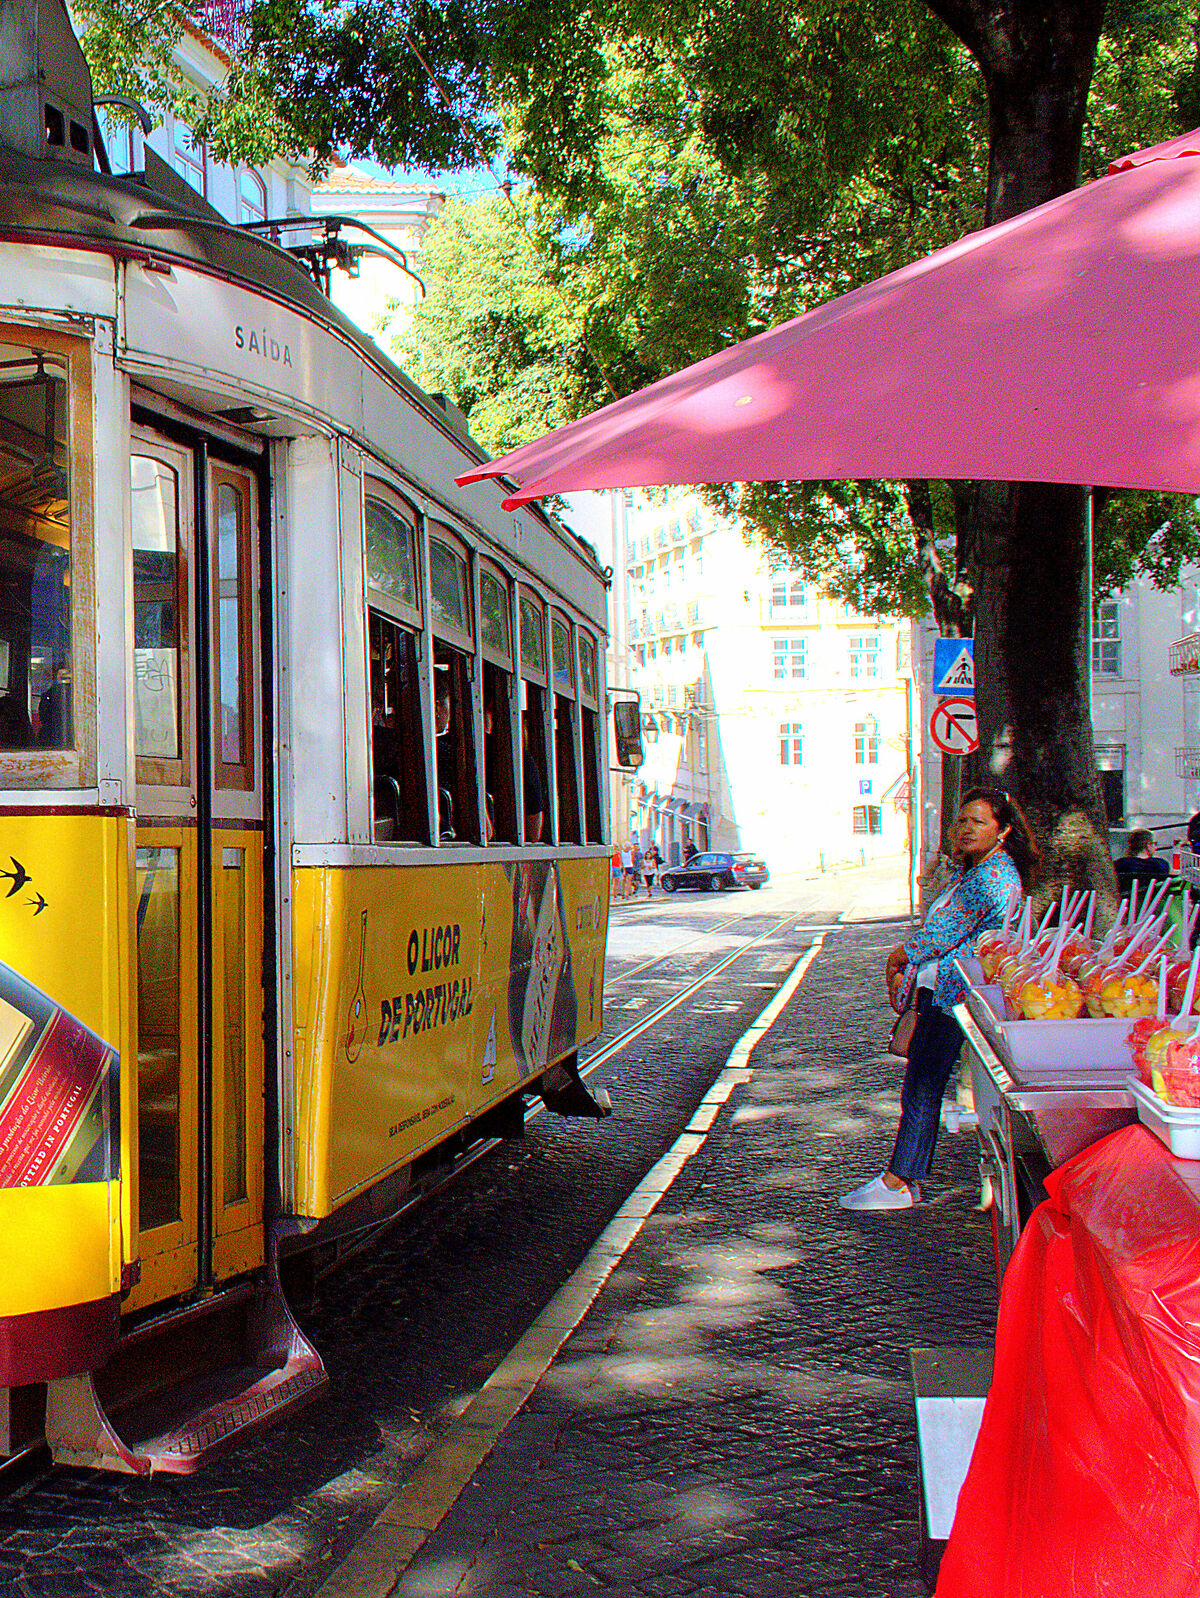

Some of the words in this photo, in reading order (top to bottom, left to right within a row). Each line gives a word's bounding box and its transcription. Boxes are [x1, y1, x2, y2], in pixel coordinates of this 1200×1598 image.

[235, 325, 292, 368] SAÍDA
[407, 929, 419, 975] O
[421, 924, 460, 973] LICOR
[377, 996, 402, 1048] DE
[403, 977, 473, 1042] PORTUGAL
[44, 1135, 55, 1148] IN
[53, 1085, 82, 1133] PORTUGAL
